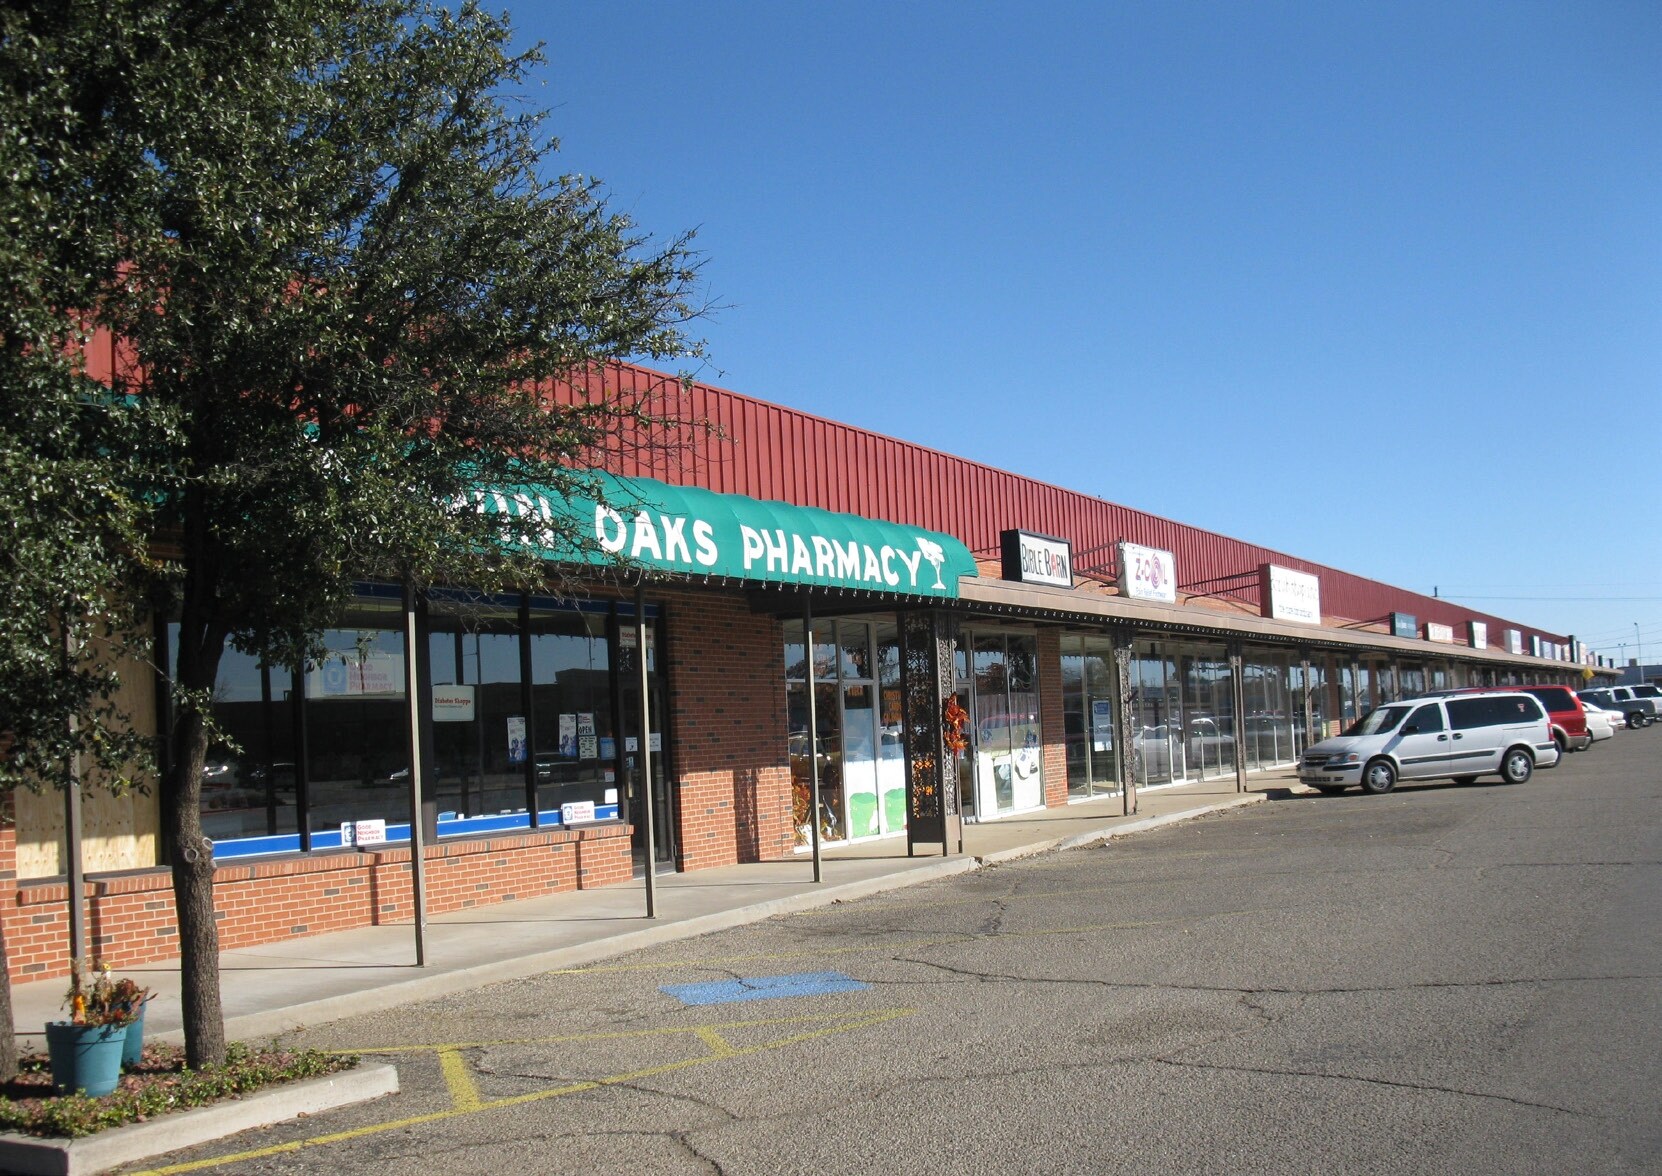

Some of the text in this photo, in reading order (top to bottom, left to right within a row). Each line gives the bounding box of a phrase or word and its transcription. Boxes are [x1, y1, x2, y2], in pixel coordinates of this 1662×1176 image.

[595, 504, 718, 566] OAKS
[739, 523, 921, 588] PHARMACY
[1021, 543, 1068, 579] BIBLE BARN
[578, 725, 592, 734] OPEN
